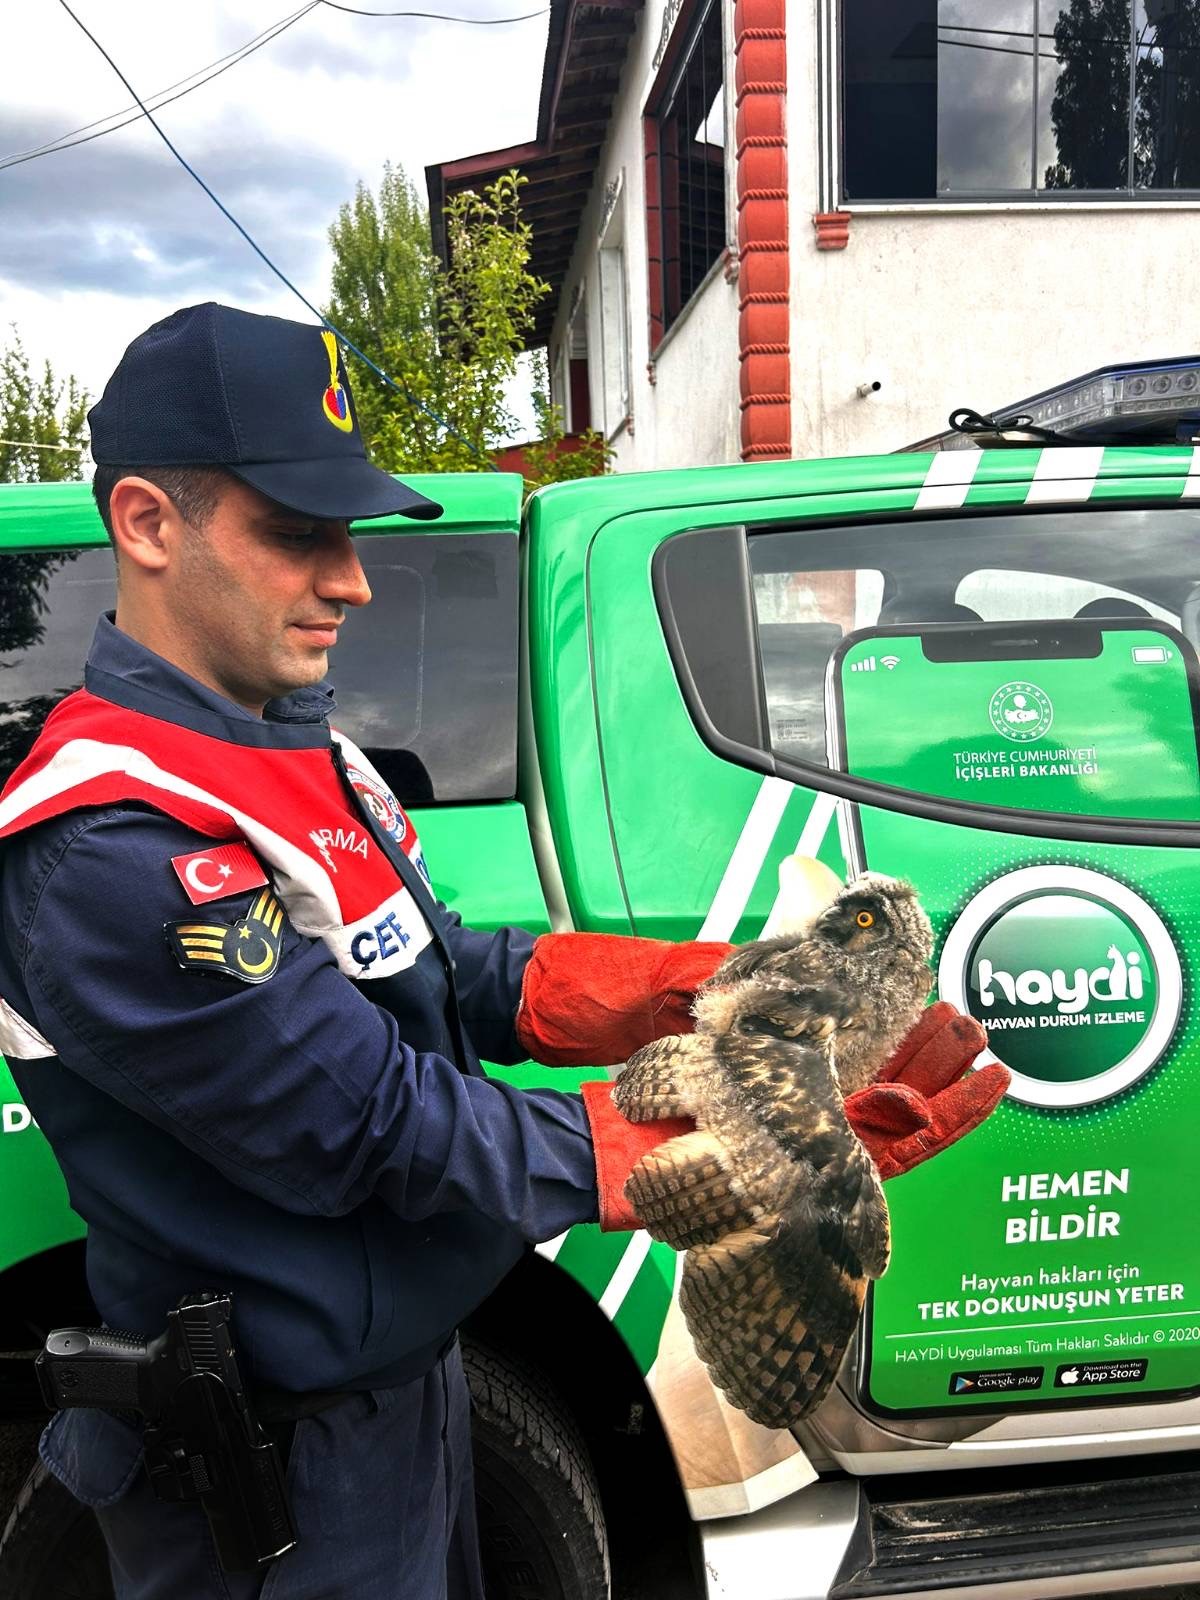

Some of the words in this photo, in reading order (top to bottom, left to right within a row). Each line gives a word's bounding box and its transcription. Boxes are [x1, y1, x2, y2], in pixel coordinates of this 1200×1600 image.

[953, 750, 1007, 765] TÜRKİYE
[1009, 747, 1097, 763] CUMHURİYETİ
[955, 764, 1015, 781] İÇİŞLERİ
[1019, 761, 1098, 777] BAKANLIĞI
[978, 944, 1144, 1013] haydi
[982, 1016, 1036, 1030] HAYVAN
[1039, 1013, 1091, 1028] DURUM
[2, 1102, 40, 1133] D
[1001, 1168, 1130, 1202] HEMEN
[1005, 1204, 1120, 1244] BİLDİR
[961, 1272, 1033, 1294] Hayvan
[1039, 1265, 1102, 1285] hakları
[1107, 1263, 1140, 1283] için
[918, 1301, 960, 1320] TEK
[965, 1289, 1111, 1313] DOKUNUŞUN
[1115, 1283, 1185, 1306] YETER
[895, 1343, 944, 1363] HAYDİ
[948, 1343, 1022, 1361] Uygulaması
[1026, 1338, 1052, 1354] Tüm
[1056, 1336, 1100, 1351] Hakları
[1104, 1331, 1150, 1347] Saklıdır
[1169, 1326, 1200, 1342] 2020
[977, 1376, 1016, 1388] Google
[1018, 1375, 1040, 1386] play
[1082, 1371, 1108, 1383] App
[1109, 1369, 1141, 1380] Store
